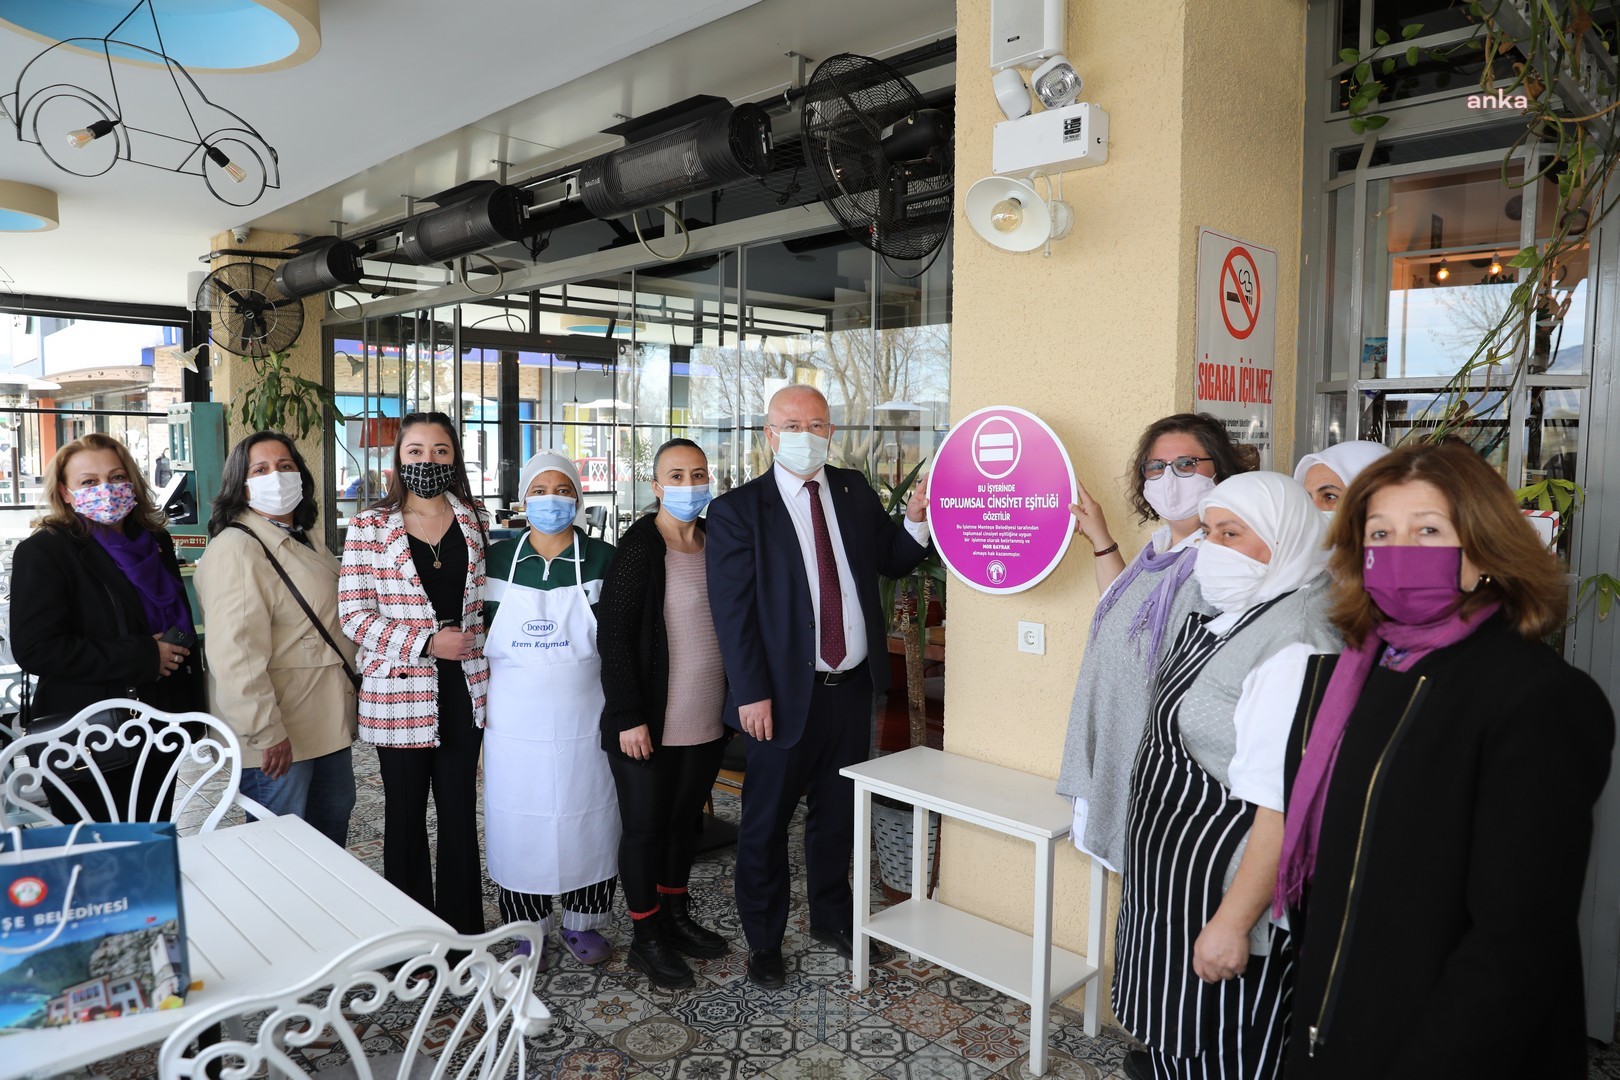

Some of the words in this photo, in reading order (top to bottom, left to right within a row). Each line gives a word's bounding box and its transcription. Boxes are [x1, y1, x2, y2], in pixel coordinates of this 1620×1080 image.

[1197, 353, 1236, 402] SİGARA
[1238, 357, 1273, 408] İÇİLMEZ
[977, 484, 986, 493] BU
[987, 482, 1016, 494] İŞYERİNDE
[939, 497, 986, 509] TOPLUMSAL
[987, 494, 1023, 509] CİNSİYET
[1025, 493, 1059, 511] EŞİTLİĞİ
[982, 511, 1011, 521] GÖZETİLİR
[196, 537, 206, 545] 112
[511, 640, 532, 648] Krem
[534, 639, 570, 650] Kaymak
[33, 897, 129, 926] BELEDİYESİ
